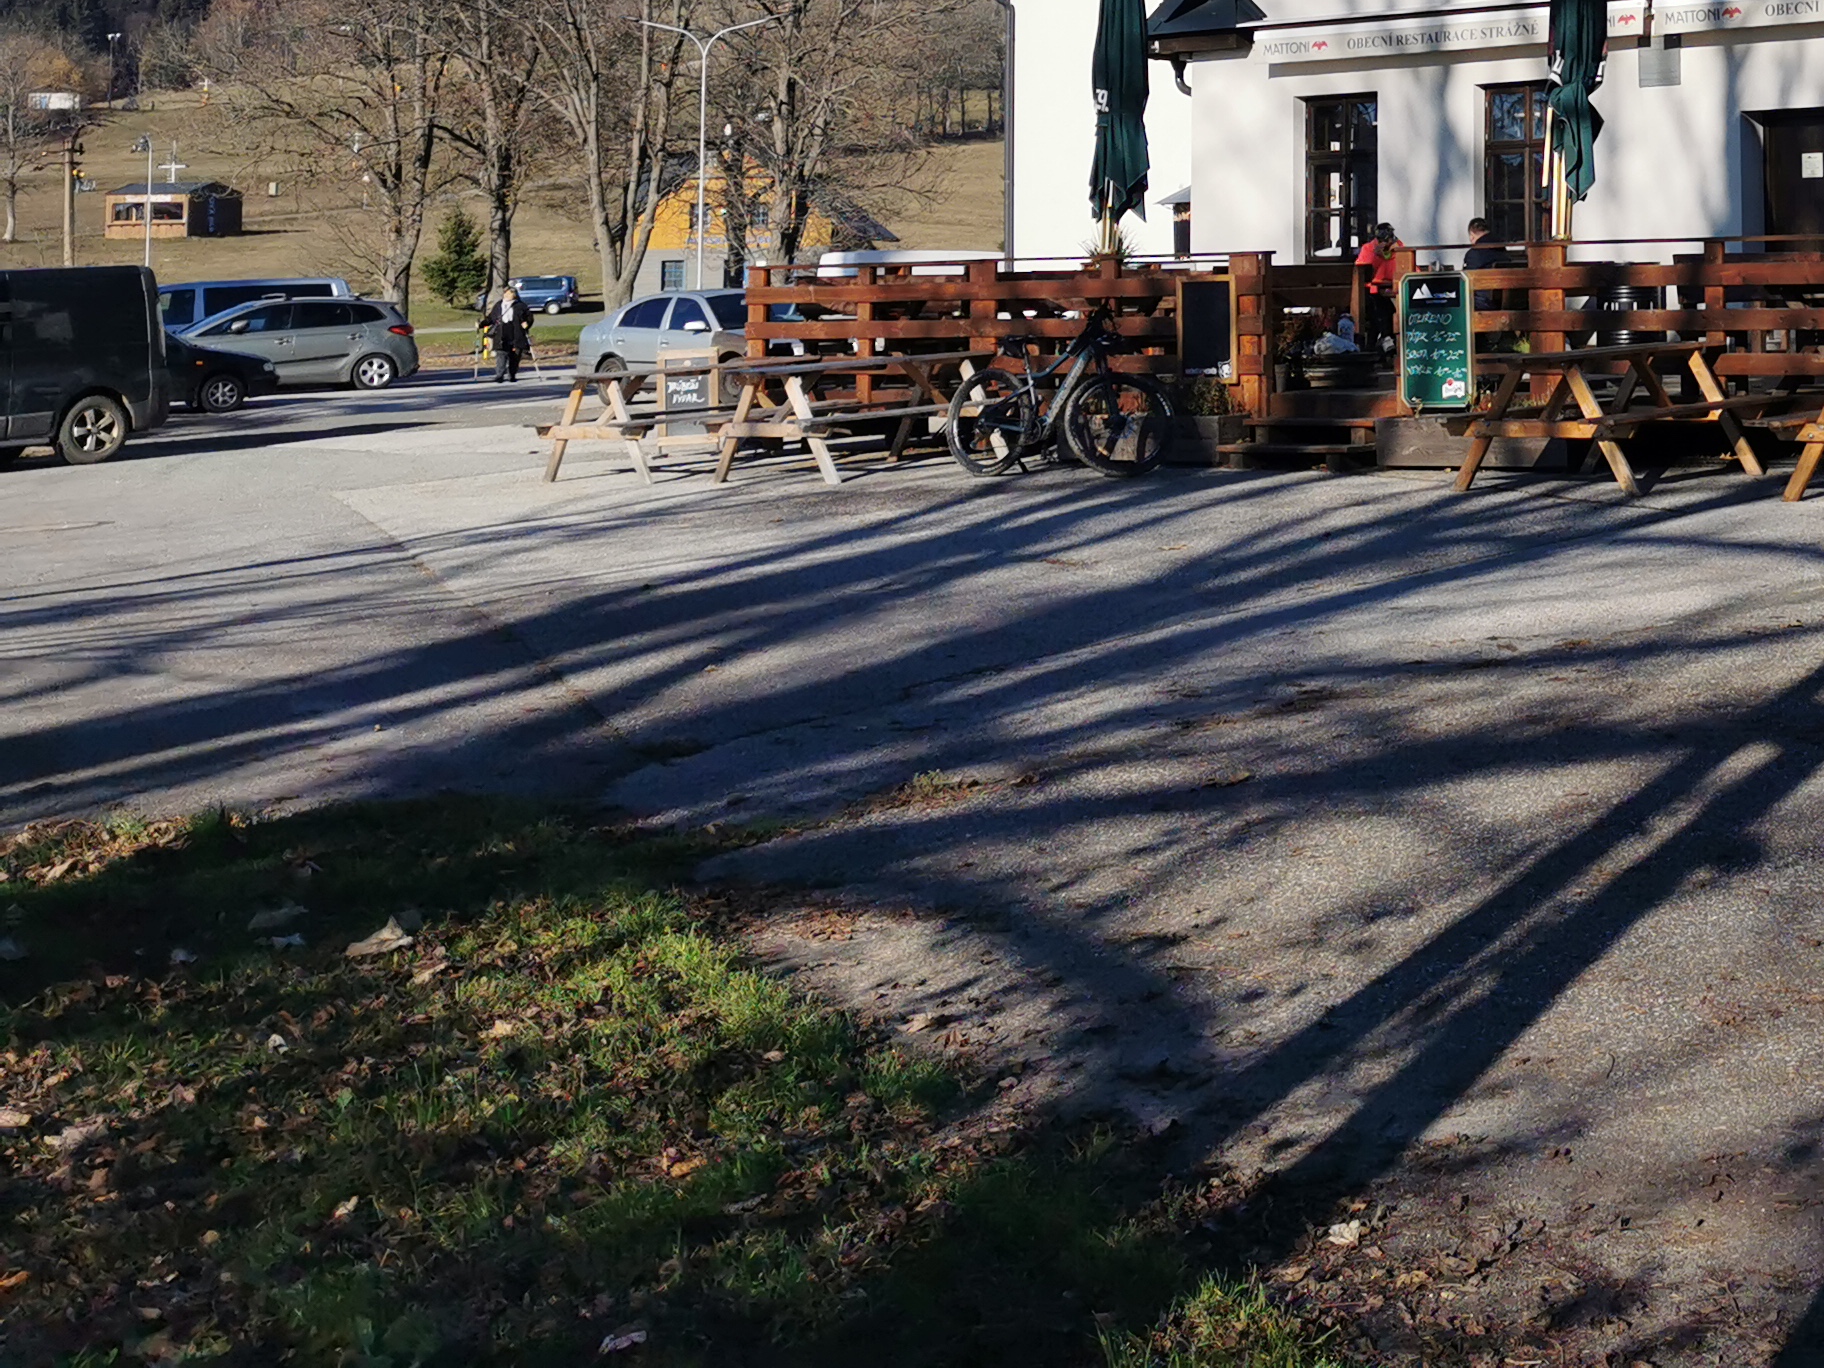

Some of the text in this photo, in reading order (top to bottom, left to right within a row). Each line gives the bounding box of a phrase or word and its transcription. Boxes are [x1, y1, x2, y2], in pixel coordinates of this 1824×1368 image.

[1664, 7, 1721, 26] MATTONI
[1347, 20, 1539, 50] OBECNÍ RESTAURACE STRÁŽNÉ
[1263, 40, 1310, 56] MATTONI
